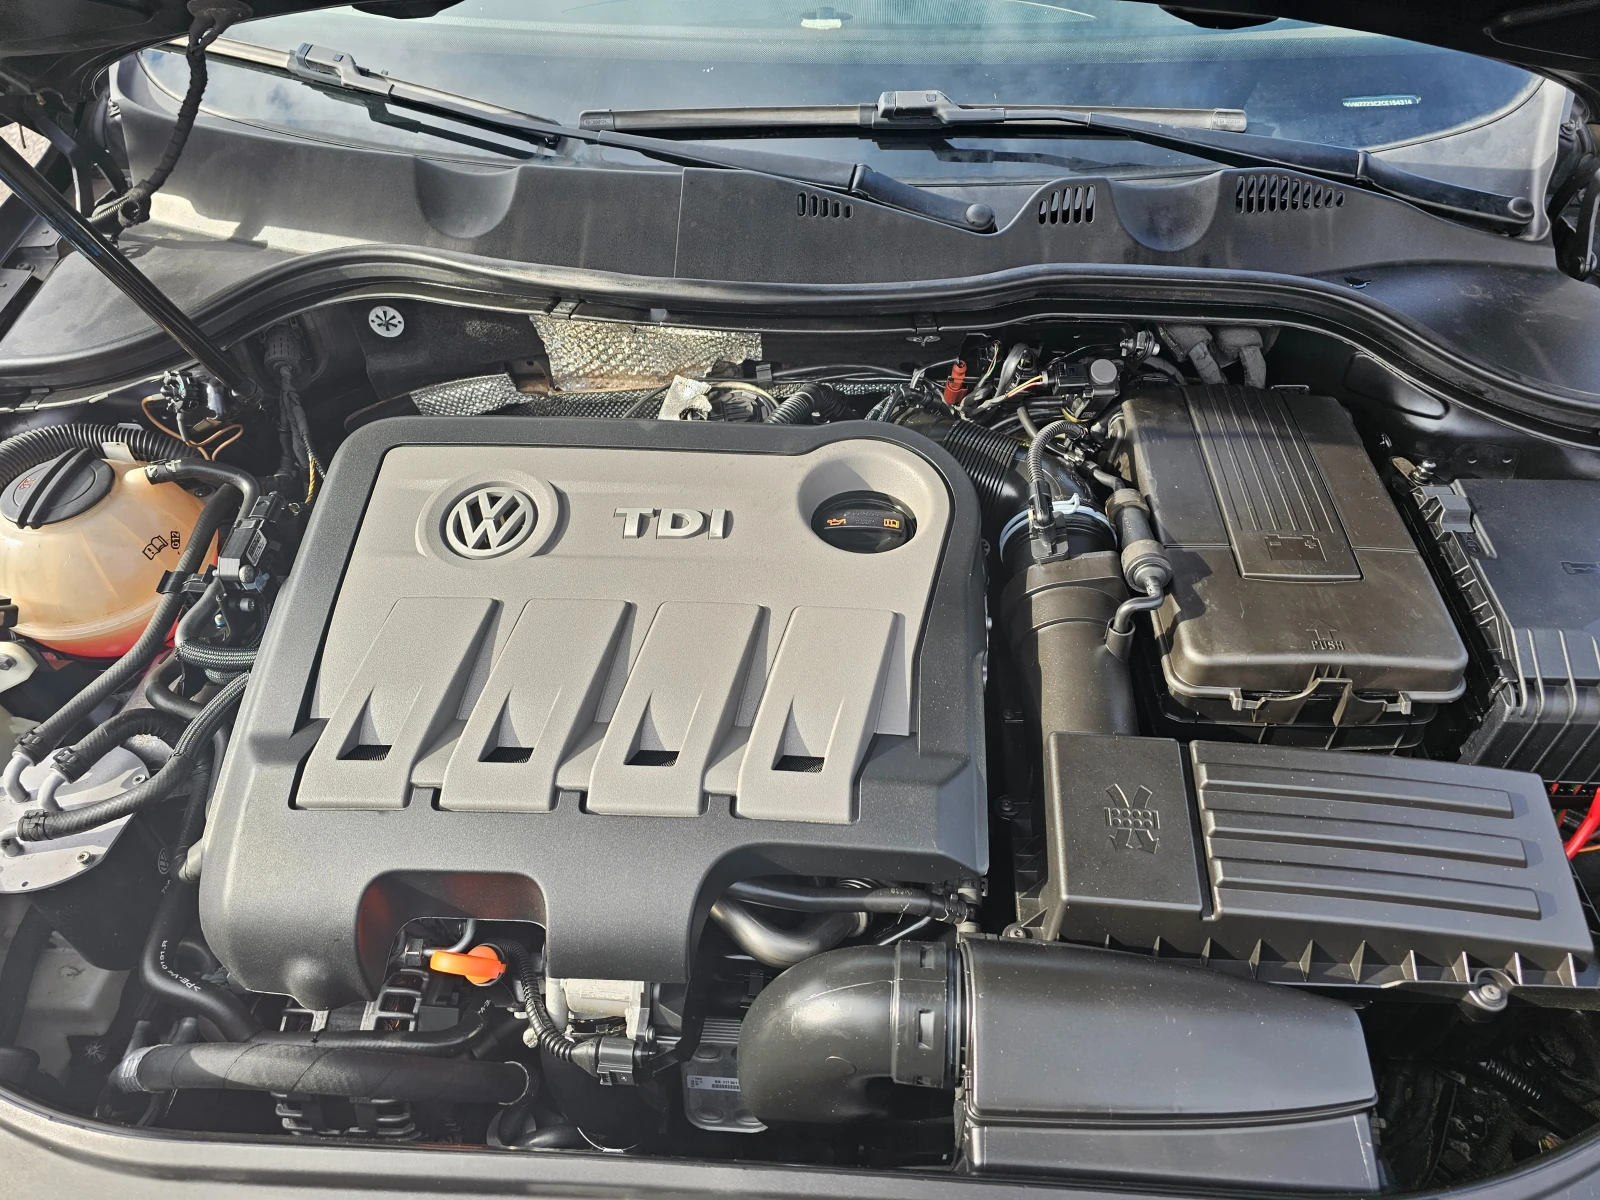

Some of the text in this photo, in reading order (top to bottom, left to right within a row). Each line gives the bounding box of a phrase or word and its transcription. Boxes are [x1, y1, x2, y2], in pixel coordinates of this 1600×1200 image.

[614, 506, 731, 540] TDI
[171, 531, 180, 549] G12
[1311, 640, 1345, 650] PUSH
